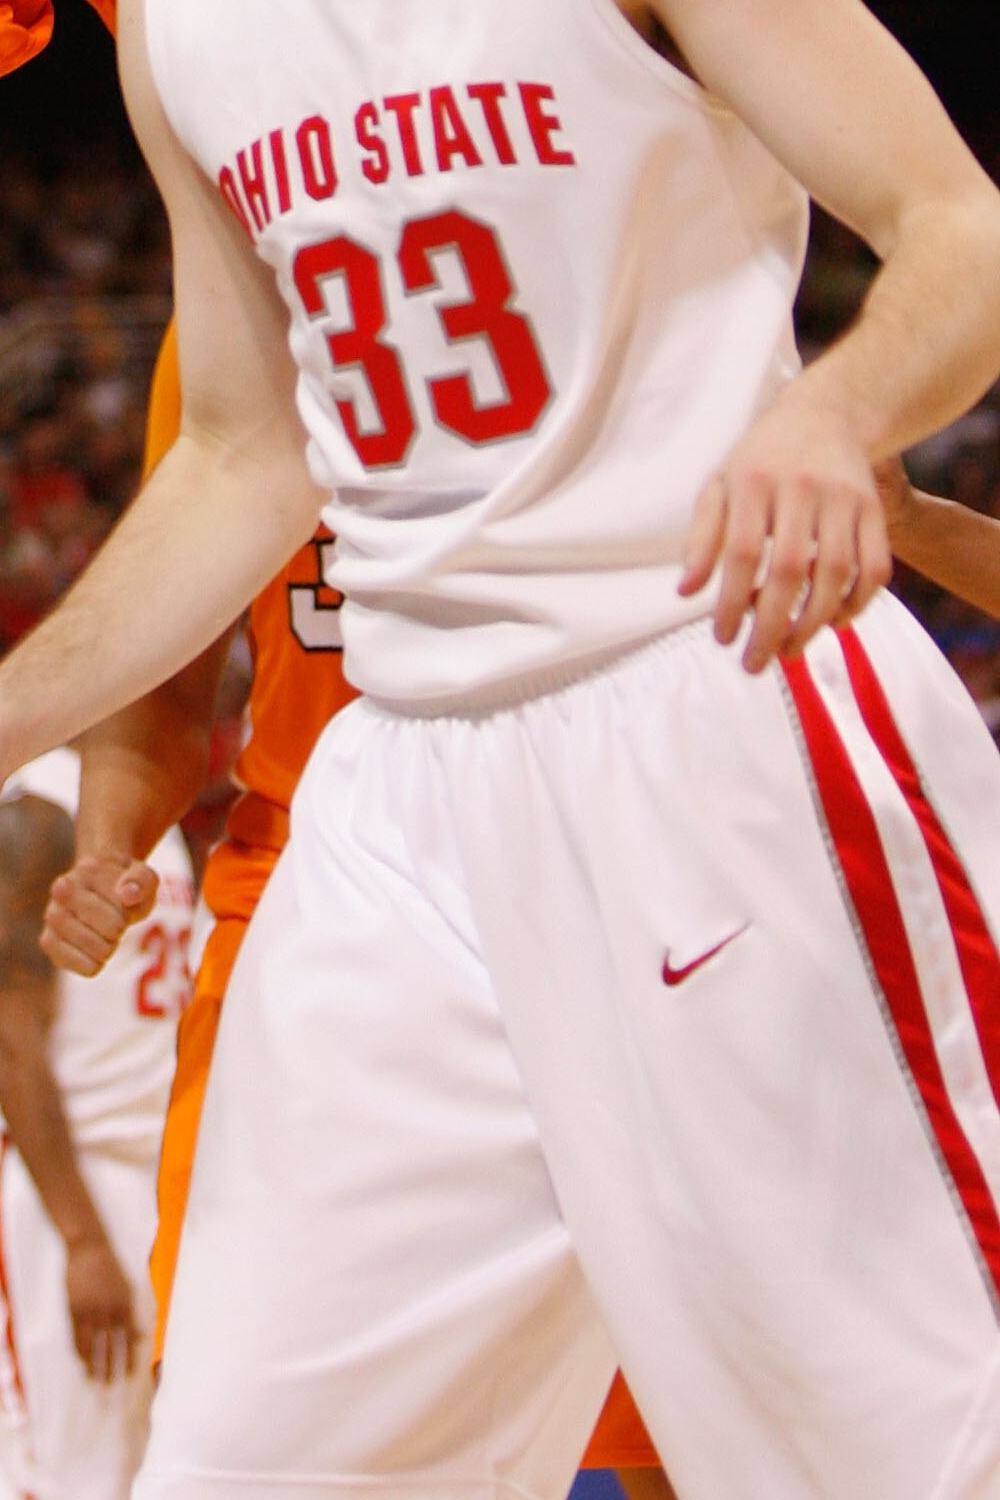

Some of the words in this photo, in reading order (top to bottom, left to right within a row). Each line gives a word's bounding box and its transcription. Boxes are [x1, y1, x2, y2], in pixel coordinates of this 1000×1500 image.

[219, 115, 338, 246] OHIO
[355, 81, 575, 185] STATE
[292, 204, 556, 472] 33
